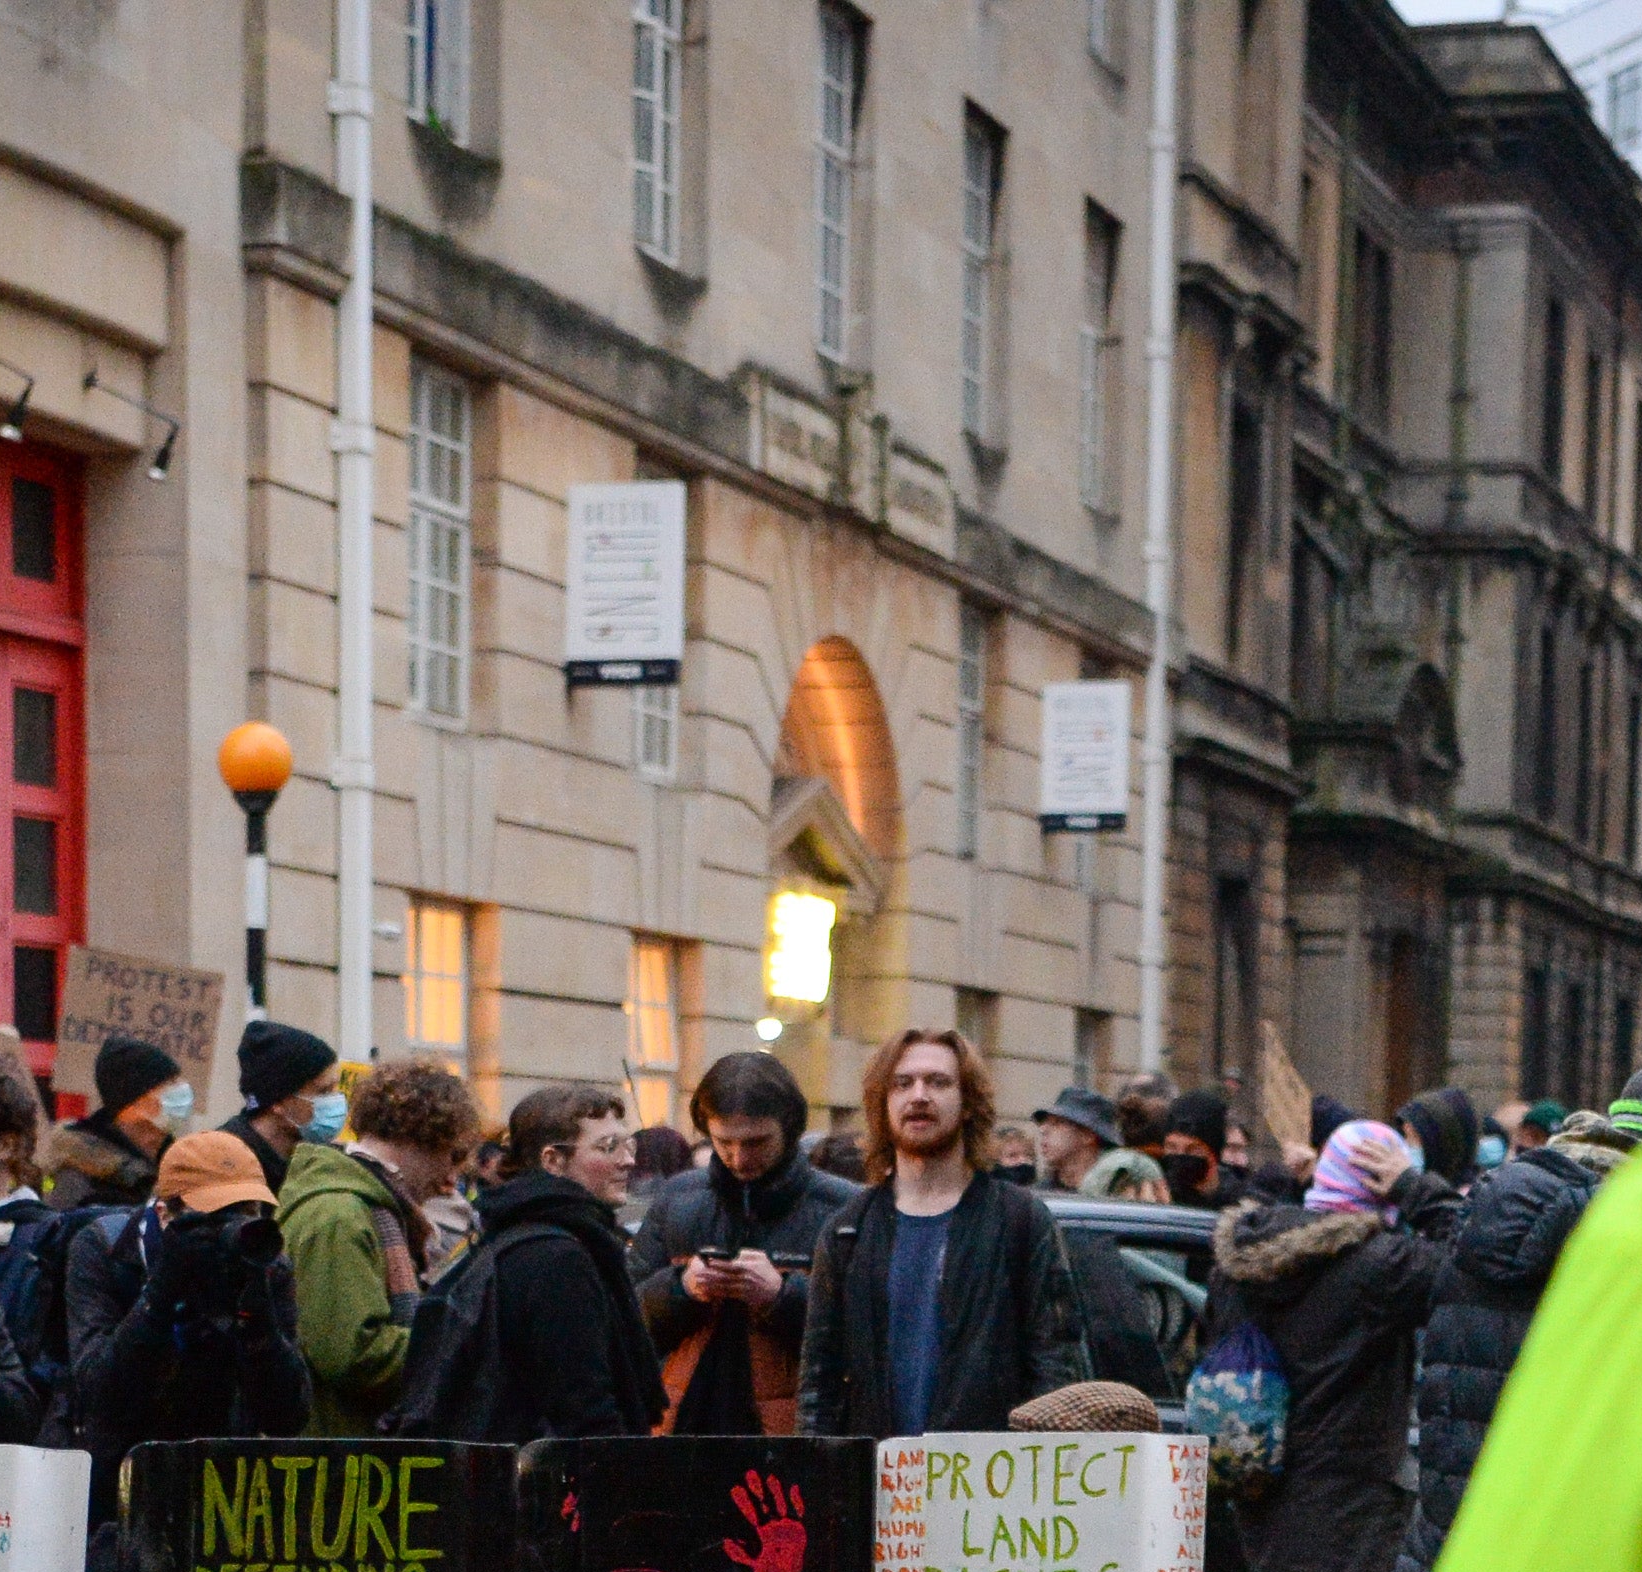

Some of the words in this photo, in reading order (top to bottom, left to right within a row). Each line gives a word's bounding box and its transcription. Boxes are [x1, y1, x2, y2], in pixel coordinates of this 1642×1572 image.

[86, 955, 212, 1001] PROTEST
[107, 993, 133, 1021] IS
[149, 1002, 206, 1034] OUR
[926, 1443, 1136, 1506] PROTECT
[203, 1454, 445, 1561] NATURE
[962, 1510, 1079, 1561] LAND
